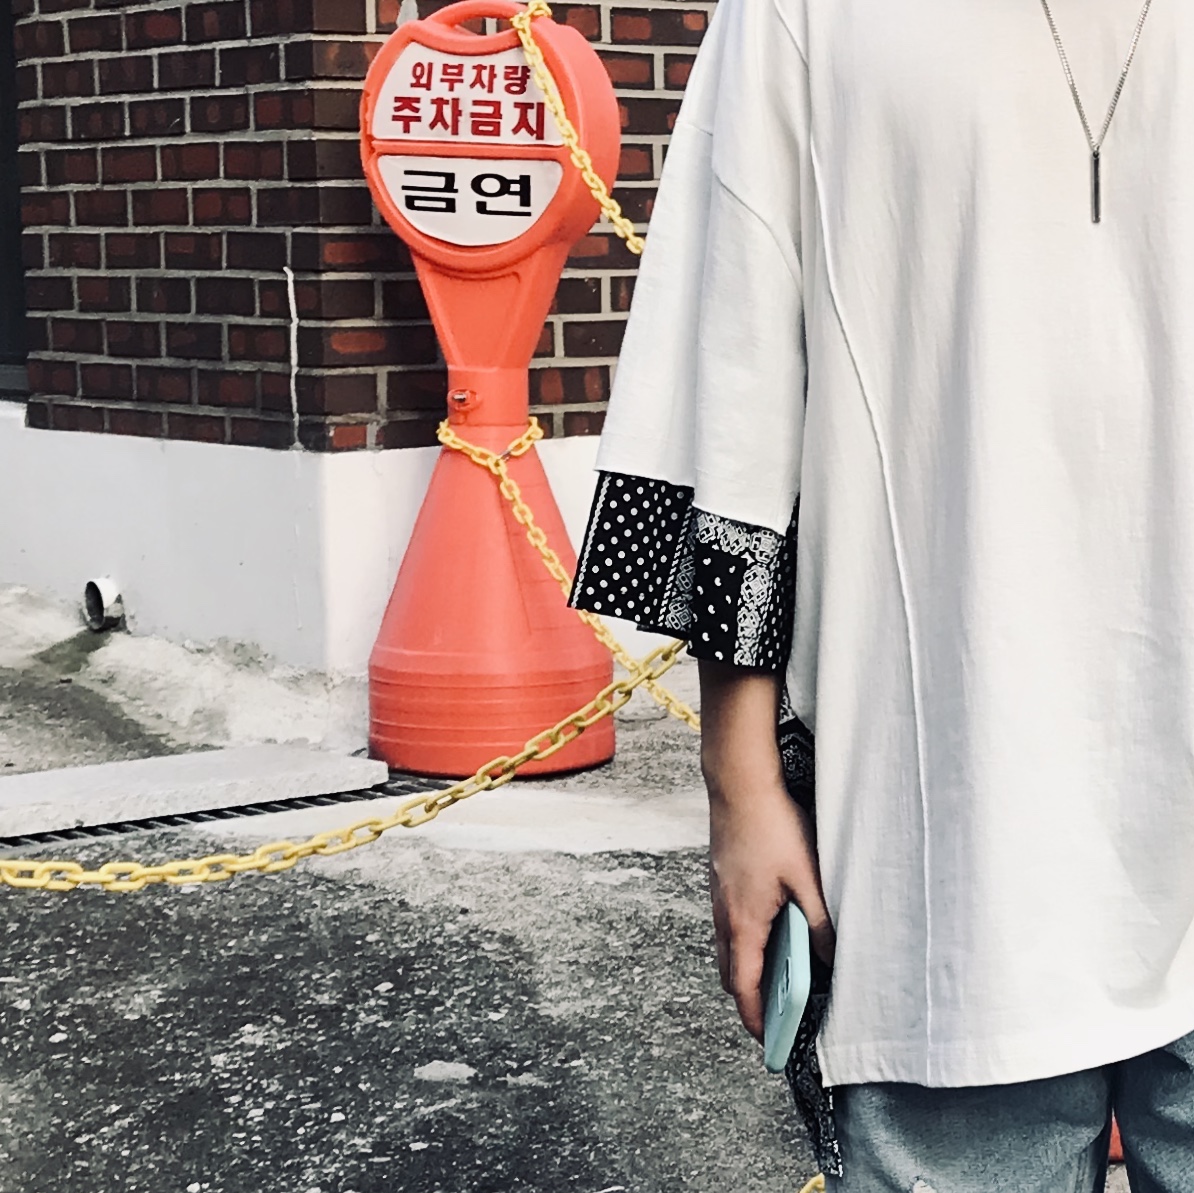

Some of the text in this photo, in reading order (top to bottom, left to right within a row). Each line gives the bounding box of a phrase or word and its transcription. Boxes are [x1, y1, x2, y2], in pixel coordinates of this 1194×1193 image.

[409, 61, 531, 95] 외부차량
[391, 96, 545, 140] 주차금지
[401, 169, 532, 217] 금연
